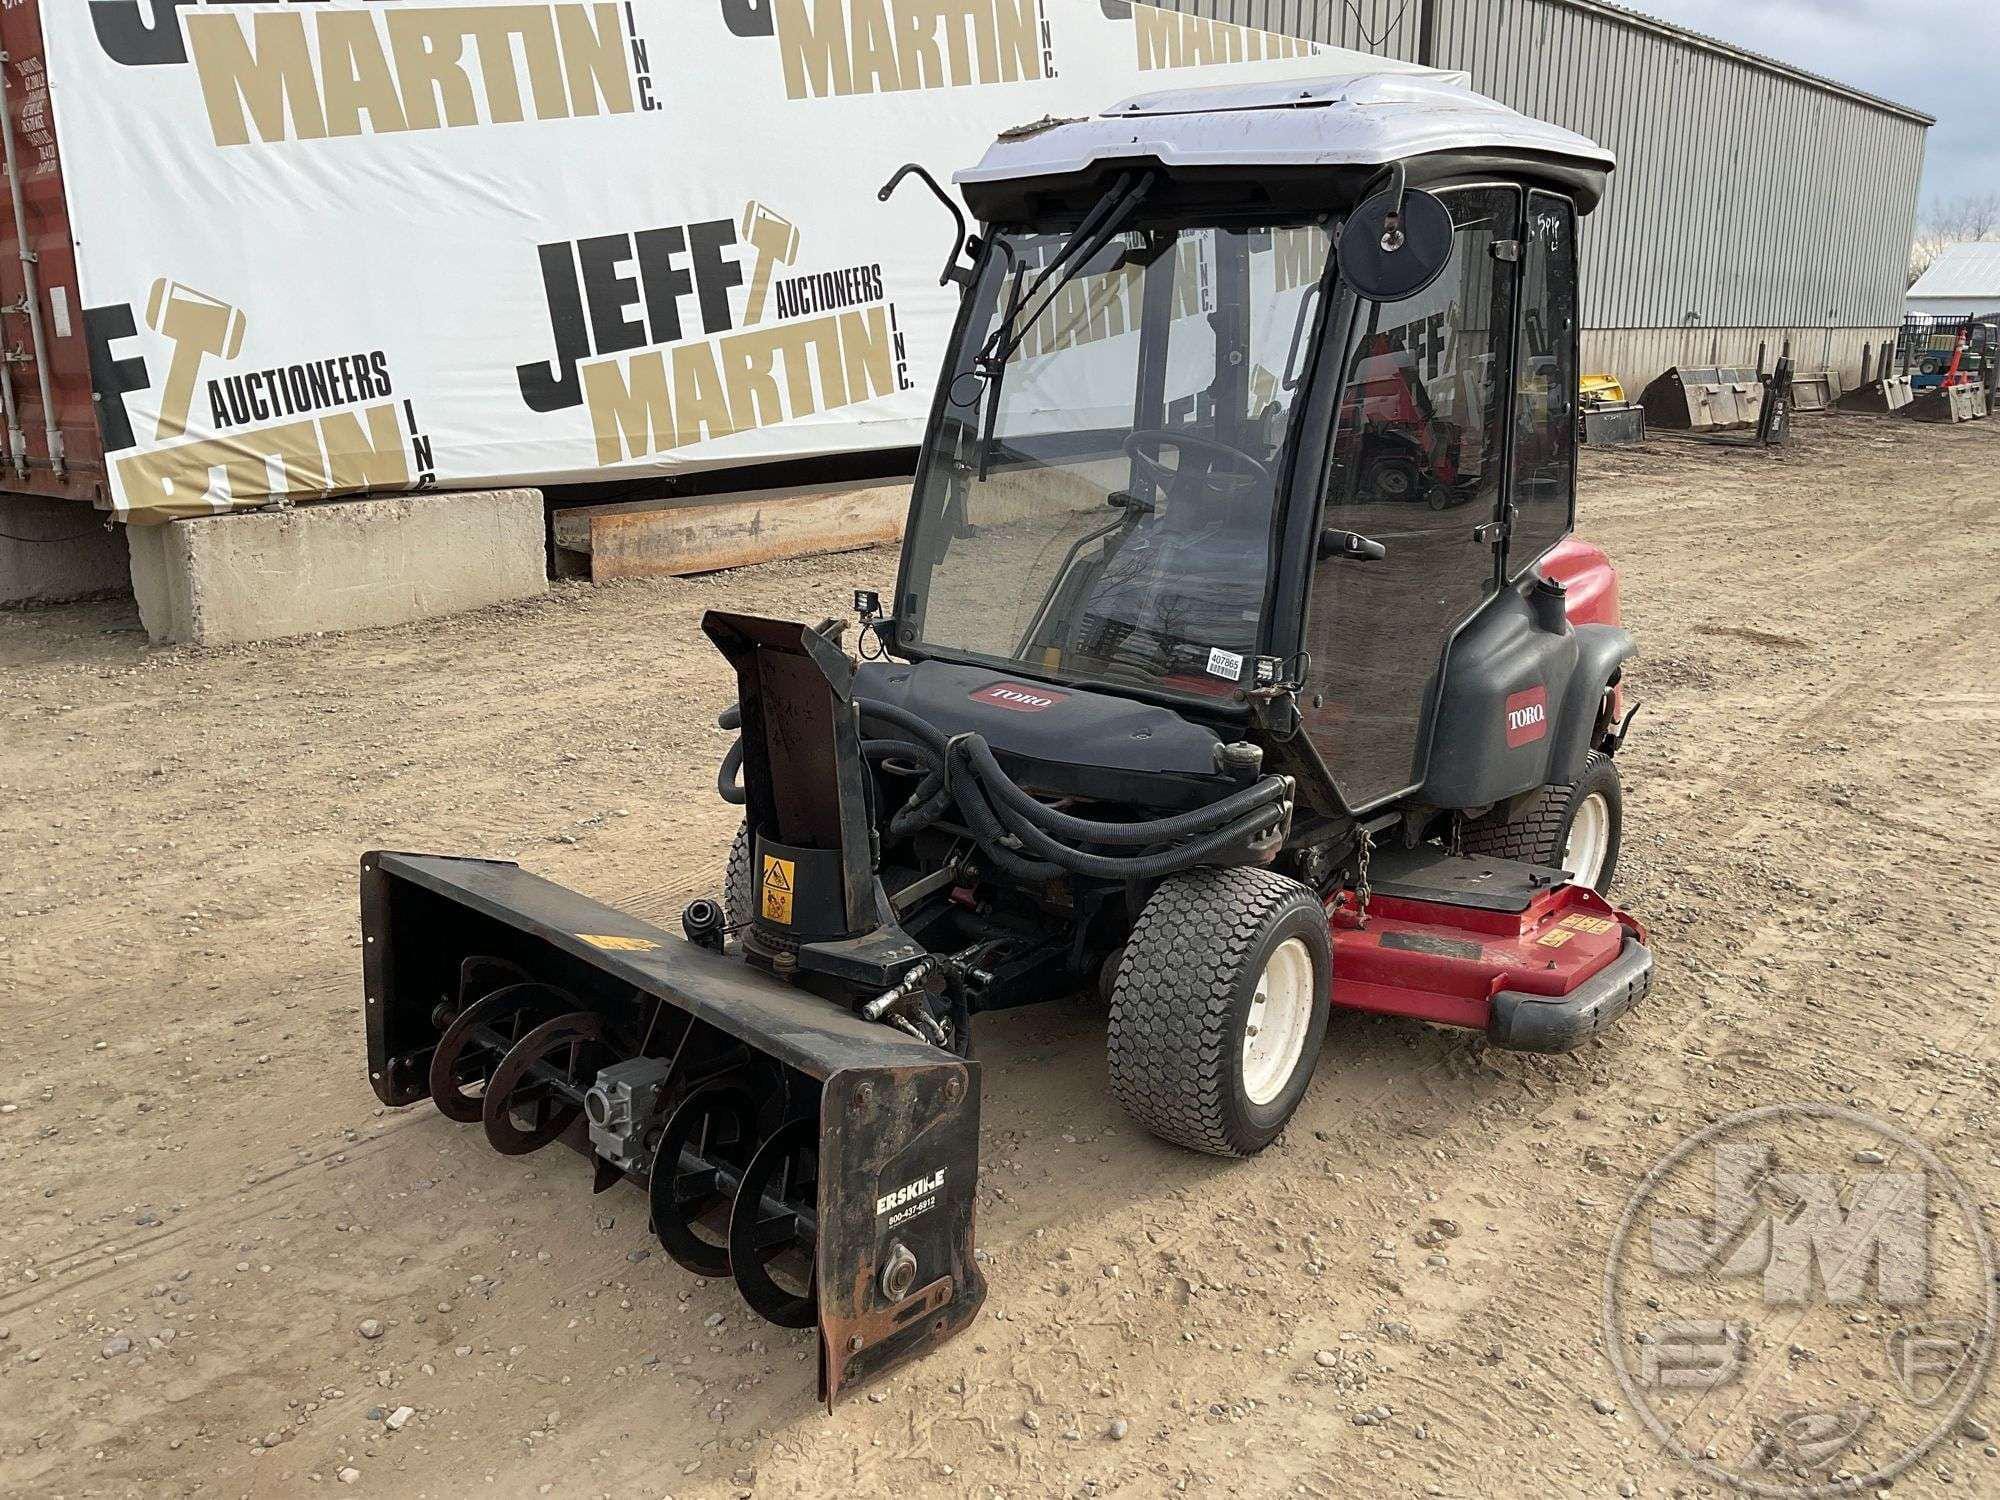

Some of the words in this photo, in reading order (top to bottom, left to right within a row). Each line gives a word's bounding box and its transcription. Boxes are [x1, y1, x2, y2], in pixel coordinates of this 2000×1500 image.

[185, 3, 634, 147] MARTIN
[774, 0, 1040, 100] MARTIN
[516, 218, 743, 413] JEFF
[776, 263, 884, 320] AUCTIONEERS
[207, 350, 392, 429] AUCTIONEERS
[582, 306, 895, 466] MARTIN
[990, 688, 1052, 706] TORO
[1211, 654, 1239, 670] 407865
